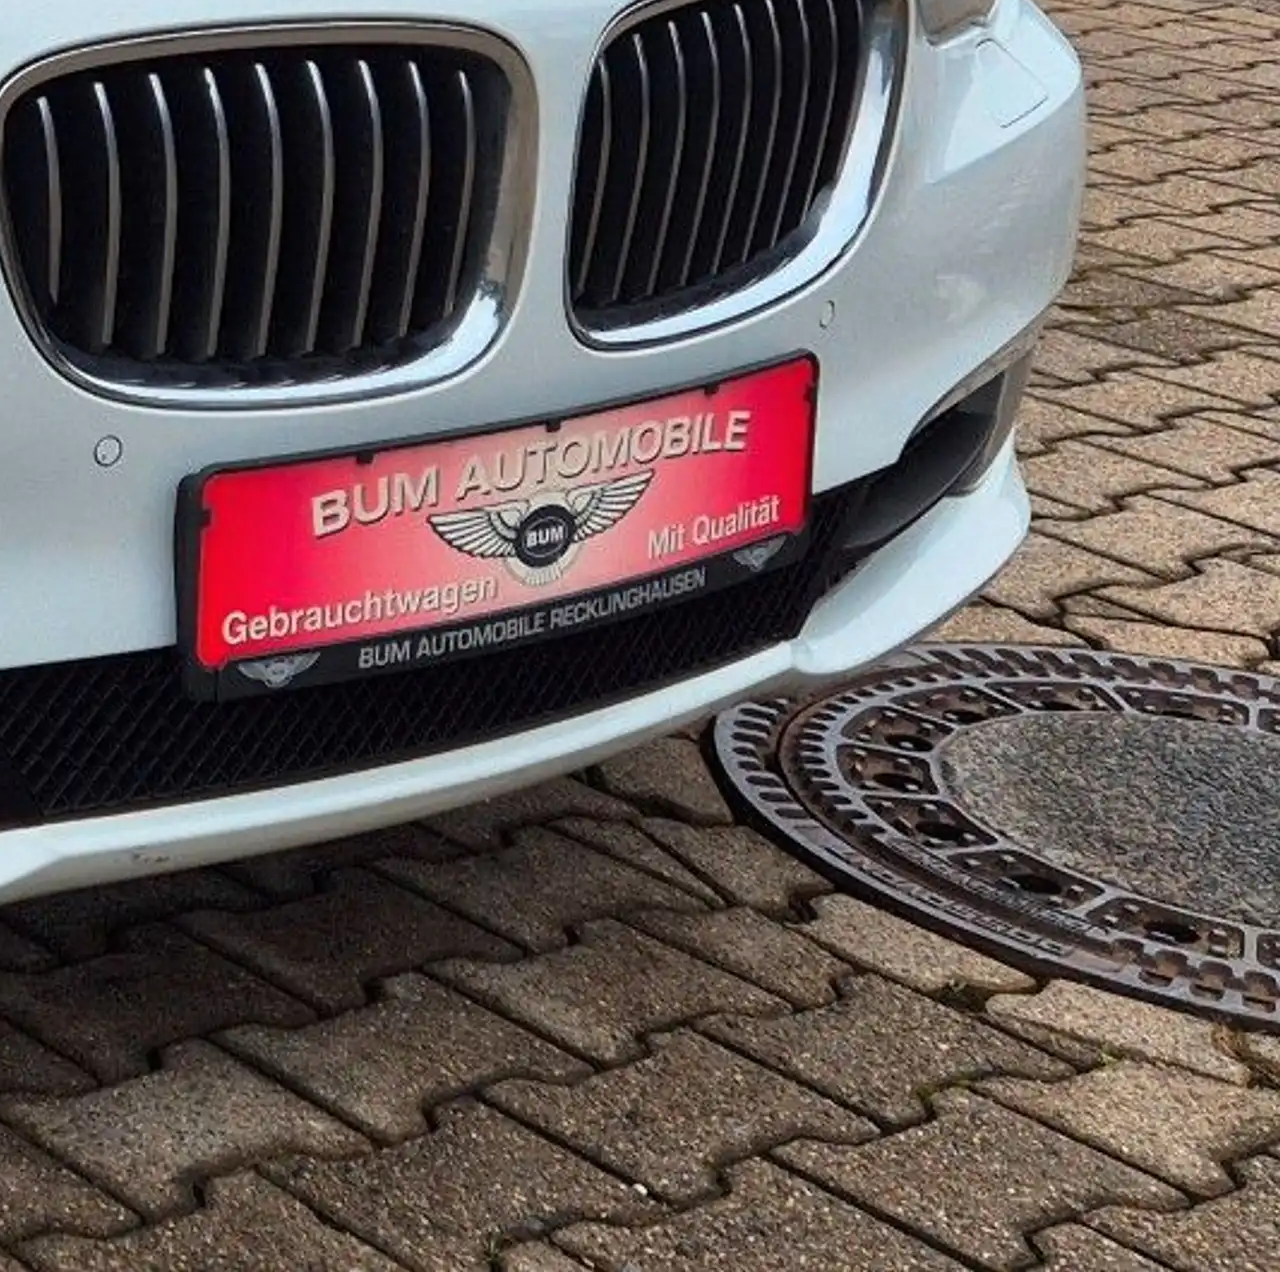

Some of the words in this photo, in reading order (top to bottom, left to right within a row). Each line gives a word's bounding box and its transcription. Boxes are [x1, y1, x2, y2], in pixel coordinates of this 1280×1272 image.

[311, 468, 439, 536] BUM
[455, 411, 750, 500] AUTOMOBILE
[526, 525, 564, 548] BUM
[648, 527, 684, 559] Mit
[692, 495, 779, 544] Qualität
[222, 575, 497, 645] Gebrauchtwagen
[358, 641, 410, 669] BUM
[415, 614, 544, 659] AUTOMOBILE
[550, 566, 706, 627] RECKLINGHAUSEN
